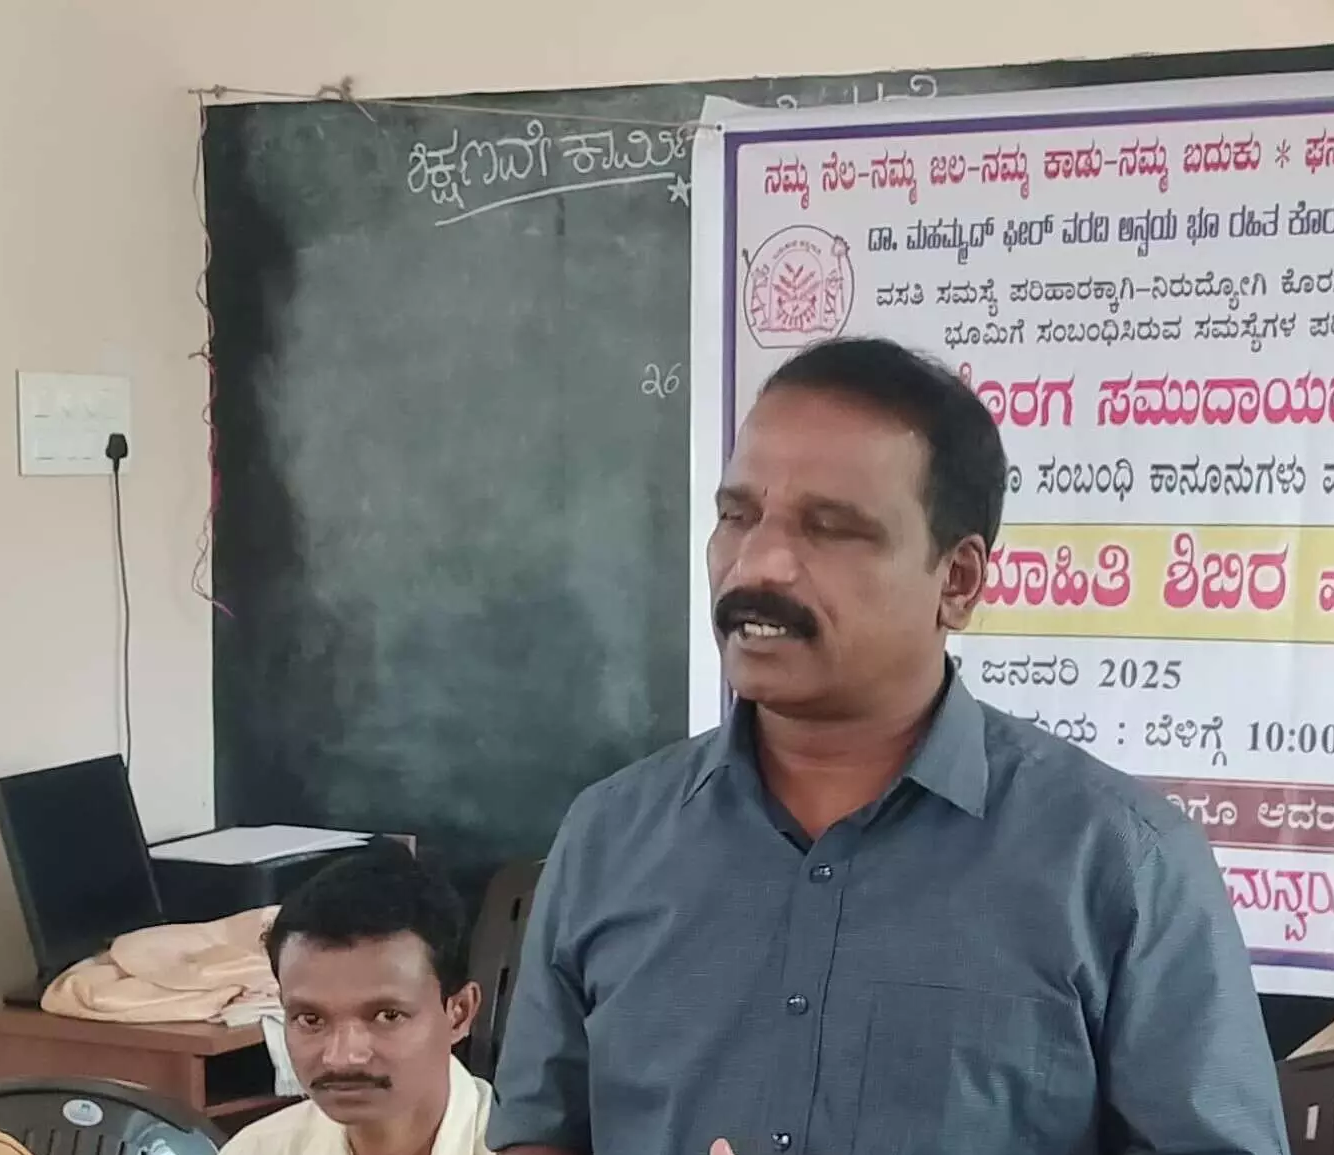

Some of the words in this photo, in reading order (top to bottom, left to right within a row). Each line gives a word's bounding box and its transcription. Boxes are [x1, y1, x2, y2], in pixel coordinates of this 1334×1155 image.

[764, 154, 809, 209] ನಮ್ಮ
[1183, 132, 1261, 173] ಬದುಕು
[1062, 211, 1109, 244] ವರದಿ
[1118, 208, 1177, 257] ಅನ್ವಯ
[1187, 206, 1219, 246] ಭೂ
[1229, 203, 1279, 238] ರಹಿತ
[876, 282, 924, 307] ವಸತಿ
[936, 278, 998, 317] ಸಮಸ್ಯೆ
[944, 318, 1025, 349] ಭೂಮಿಗೆ
[1036, 316, 1183, 346] ಸಂಬಂಧಿಸಿರುವ
[1194, 311, 1296, 353] ಸಮಸ್ಯೆಗಳ
[1035, 456, 1134, 502] ಸಂಬಂಧಿ
[1149, 454, 1306, 497] ಕಾನೂನುಗಳು
[1165, 531, 1289, 610] ಶಿಬಿರ
[982, 654, 1079, 686] ಜನವರಿ
[1098, 658, 1183, 690] 2025
[1144, 709, 1228, 767] ಬೆಳಿಗ್ಗೆ
